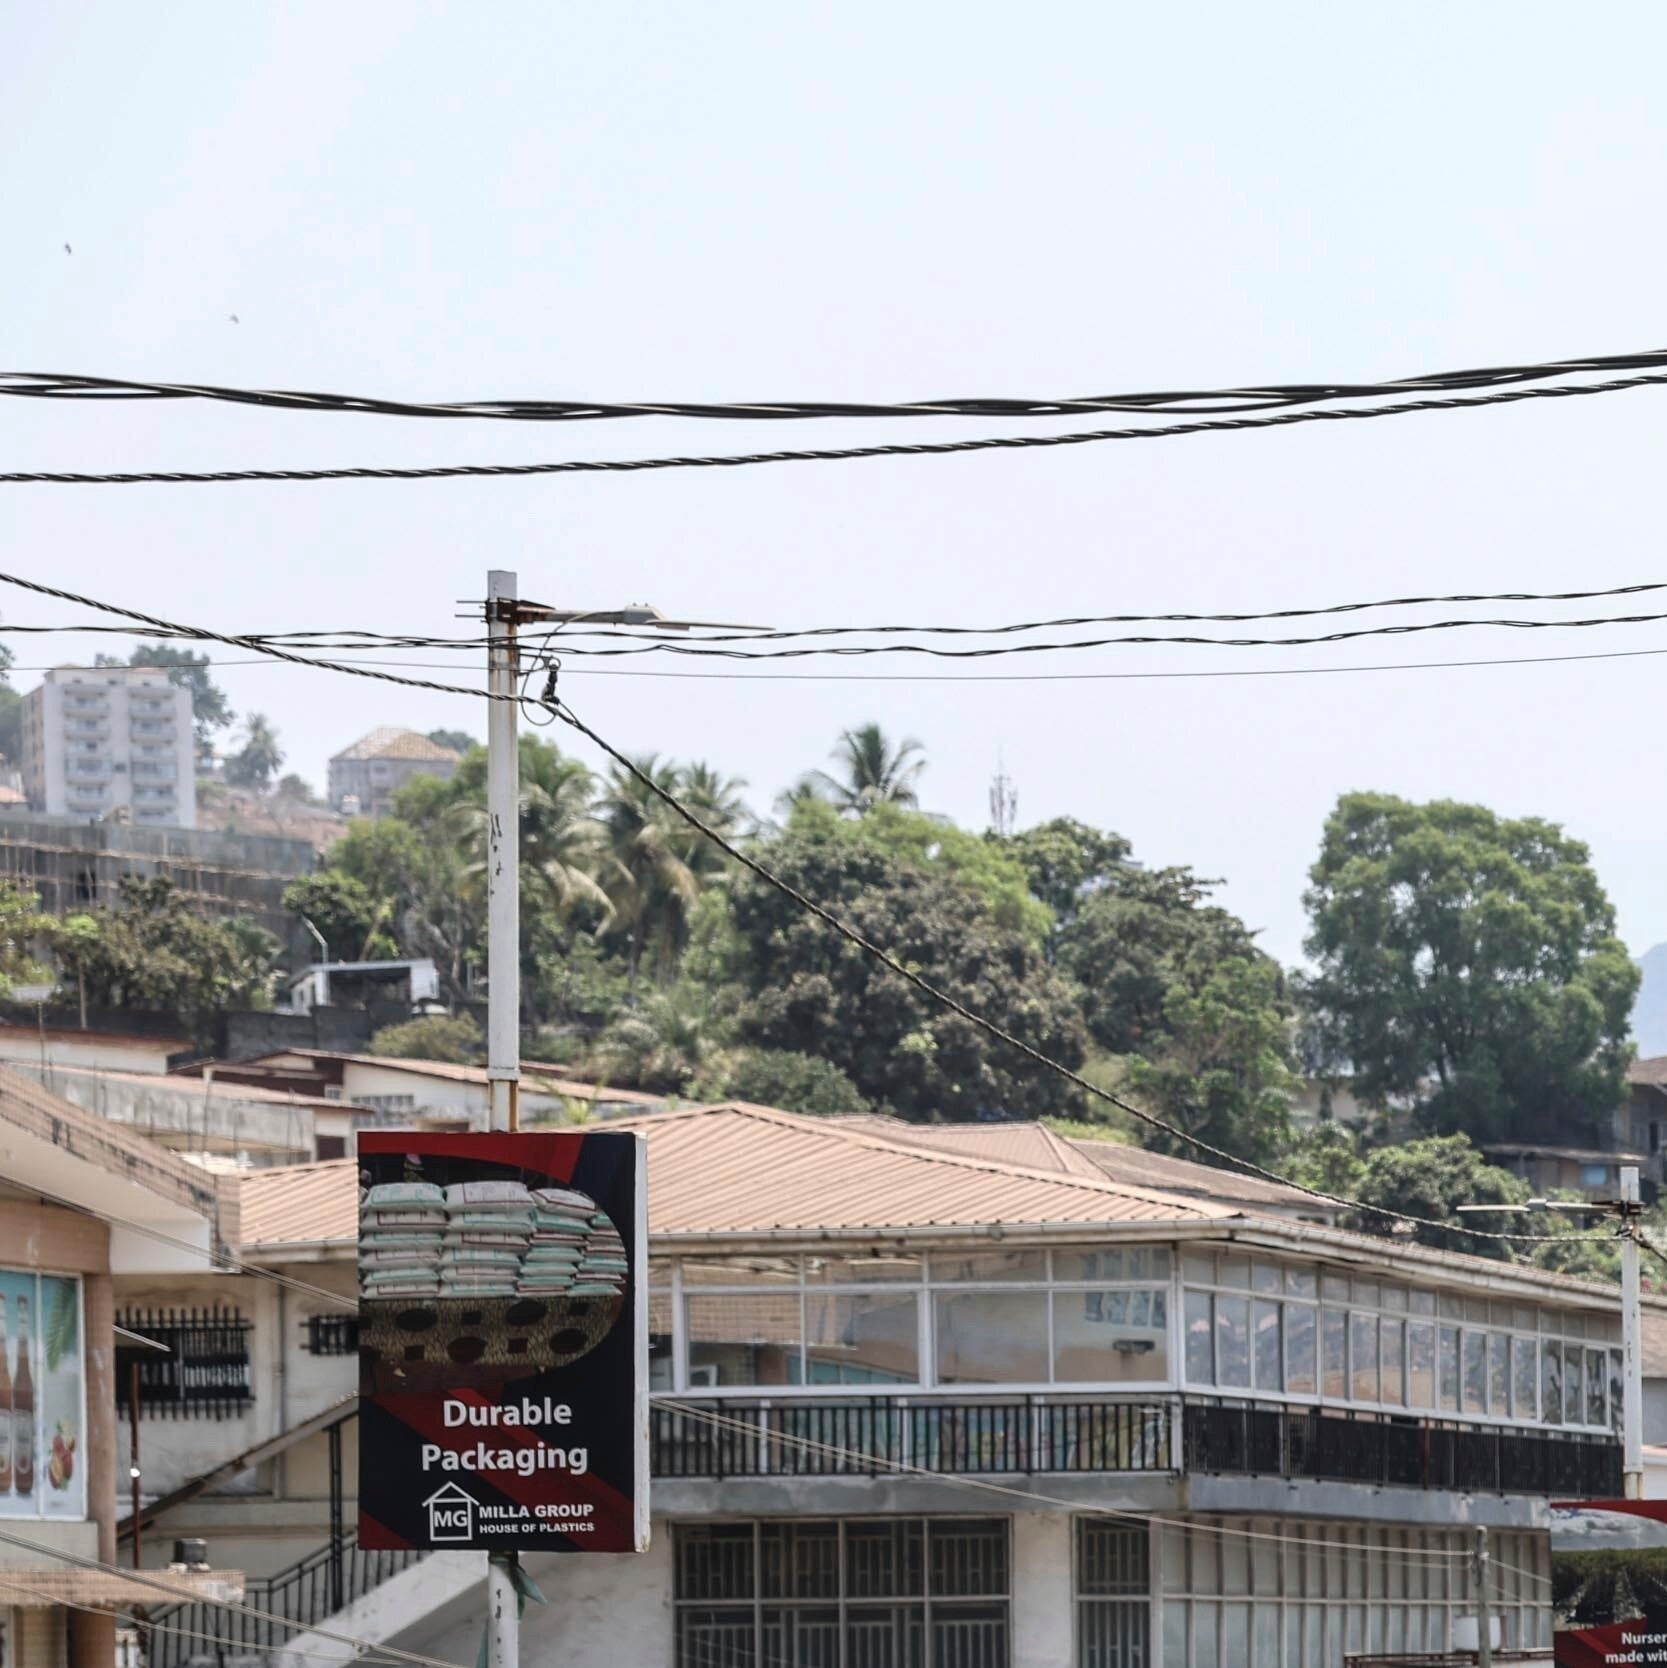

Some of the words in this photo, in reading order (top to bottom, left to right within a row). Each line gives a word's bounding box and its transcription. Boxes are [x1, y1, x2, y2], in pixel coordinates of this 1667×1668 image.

[443, 1397, 572, 1427] Durable
[422, 1441, 587, 1476] Packaging
[434, 1510, 467, 1527] MG
[479, 1505, 530, 1518] MILLA
[534, 1504, 594, 1517] GROUP
[479, 1524, 518, 1533] HOUSE
[522, 1523, 536, 1532] OF
[539, 1522, 594, 1532] PLASTICS
[1605, 1650, 1644, 1663] made
